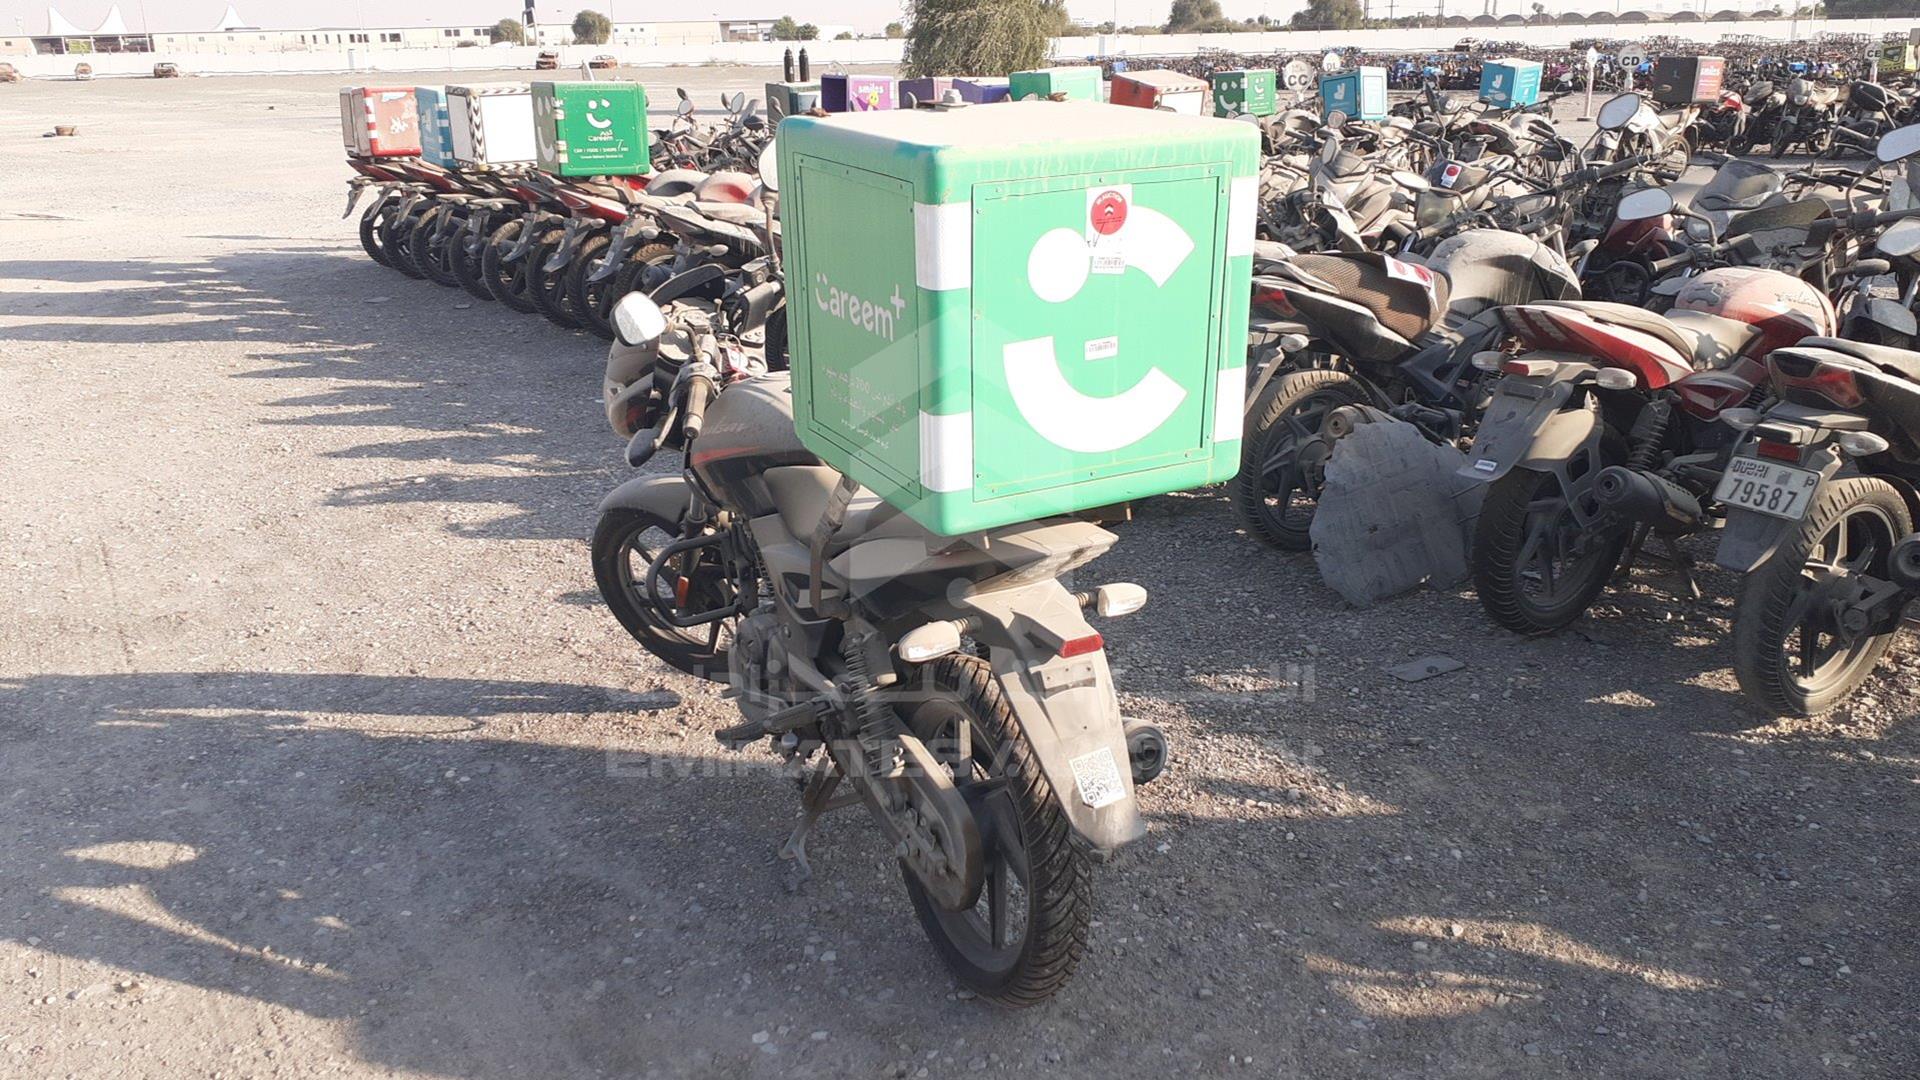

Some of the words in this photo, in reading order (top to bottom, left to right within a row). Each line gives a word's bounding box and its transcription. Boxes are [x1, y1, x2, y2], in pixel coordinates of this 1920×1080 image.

[1621, 56, 1640, 66] CD
[1287, 74, 1308, 86] CC
[858, 83, 885, 93] smiles
[1731, 459, 1770, 479] DUBAI
[1728, 478, 1798, 514] 79587
